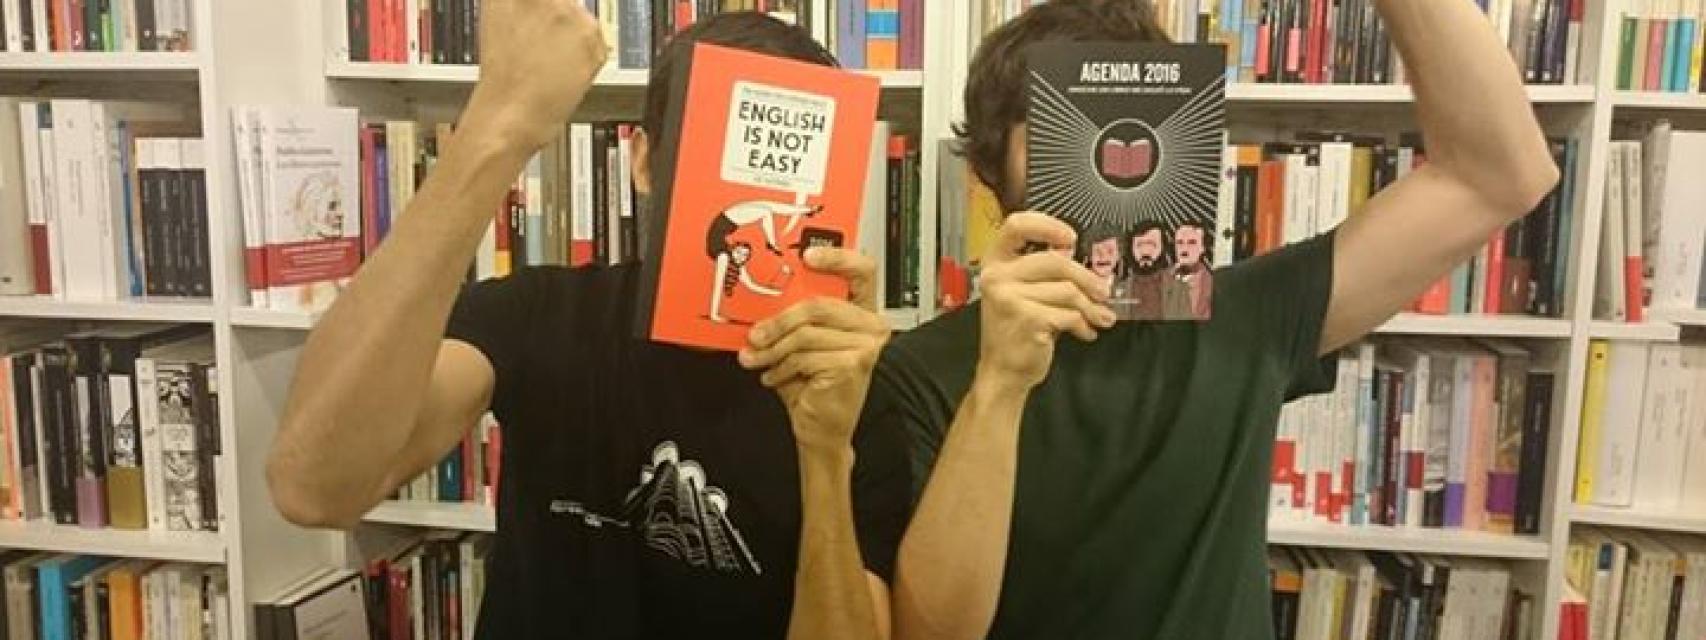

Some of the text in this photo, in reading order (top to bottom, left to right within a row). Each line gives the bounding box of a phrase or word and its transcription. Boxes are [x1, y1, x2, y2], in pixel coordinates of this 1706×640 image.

[1080, 62, 1181, 83] AGENDA 2016
[738, 101, 825, 133] ENGLISH
[743, 125, 813, 154] IS NOT
[748, 149, 802, 174] EASY
